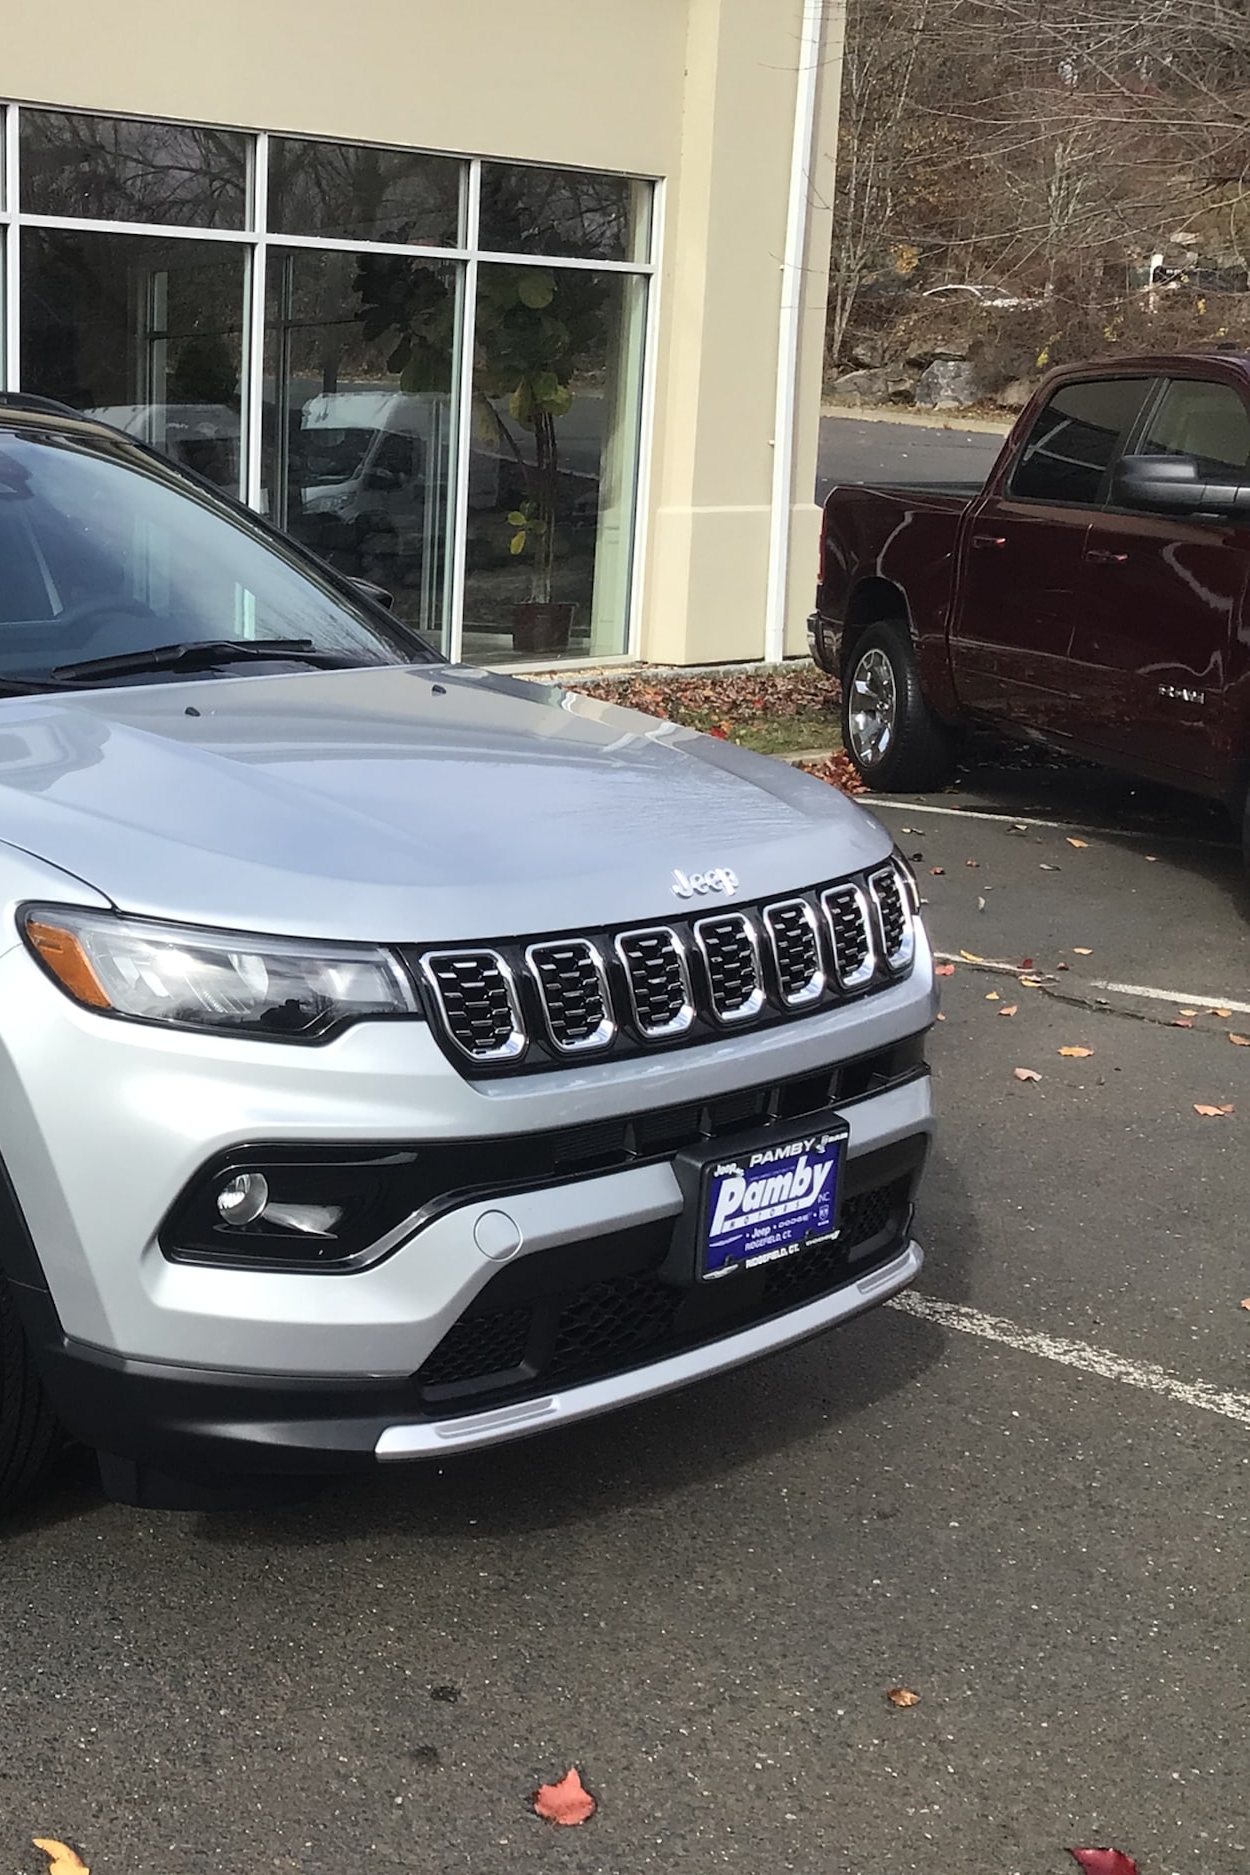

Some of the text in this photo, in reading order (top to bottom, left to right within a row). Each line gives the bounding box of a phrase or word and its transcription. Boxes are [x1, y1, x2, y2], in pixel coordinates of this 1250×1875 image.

[670, 868, 739, 899] Jeep
[749, 1138, 816, 1168] PAMBY
[709, 1155, 833, 1238] Pamby
[730, 1201, 800, 1228] MOTORS
[751, 1225, 771, 1239] Jeep
